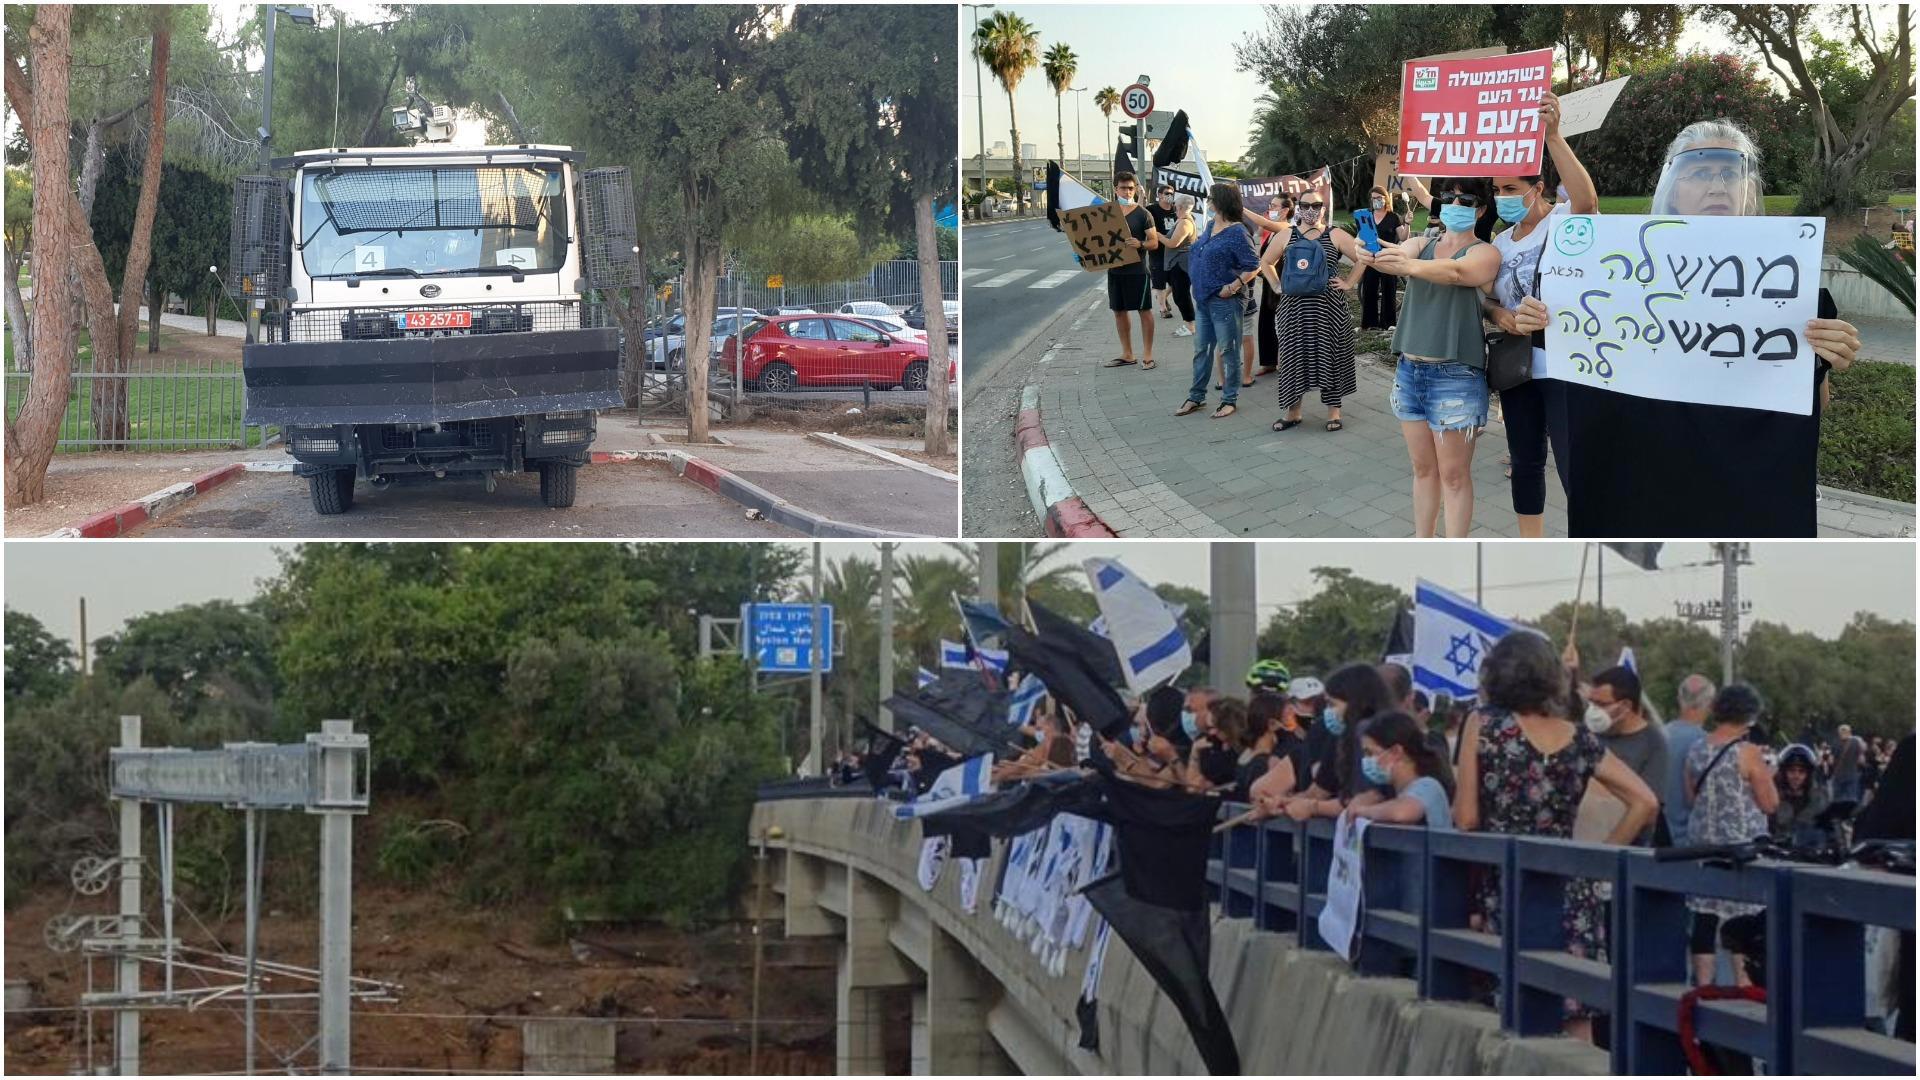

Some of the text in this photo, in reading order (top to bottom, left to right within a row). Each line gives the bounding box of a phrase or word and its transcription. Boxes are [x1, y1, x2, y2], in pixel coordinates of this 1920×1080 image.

[1448, 66, 1545, 87] כשהממשלה
[1128, 93, 1148, 110] 50
[1478, 88, 1511, 105] העם
[1517, 86, 1546, 103] נגד
[1421, 111, 1467, 135] נגד
[1476, 108, 1540, 135] העם
[1406, 135, 1537, 164] הממשלה
[362, 251, 378, 268] 4
